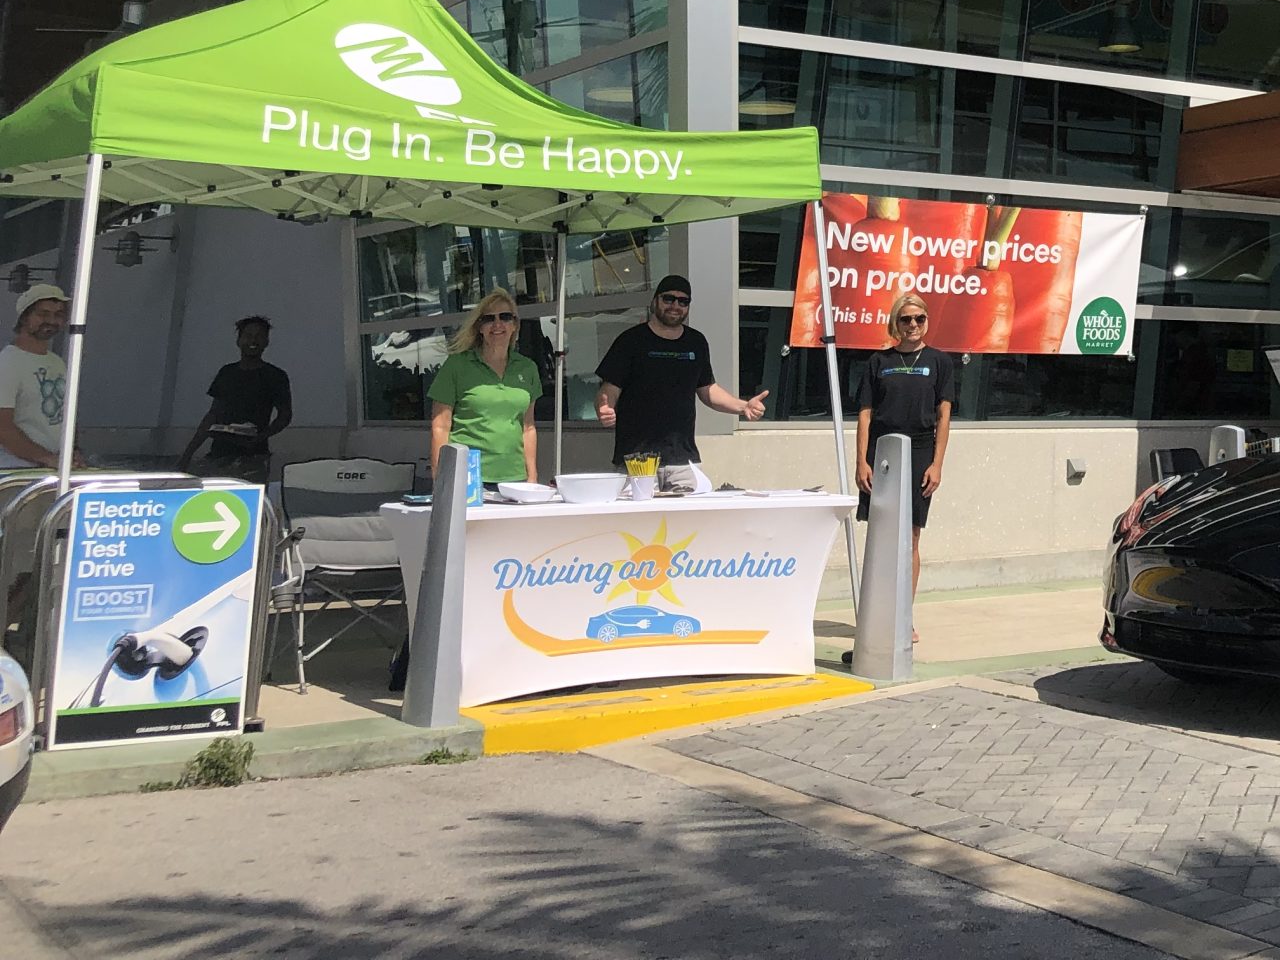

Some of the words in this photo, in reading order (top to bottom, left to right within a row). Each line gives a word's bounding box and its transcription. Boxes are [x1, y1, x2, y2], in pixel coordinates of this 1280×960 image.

[261, 104, 372, 161] Plug
[392, 120, 444, 164] In.
[465, 130, 525, 169] Be
[543, 136, 693, 181] Happy.
[827, 221, 895, 254] New
[902, 227, 978, 259] lower
[982, 234, 1062, 266] prices
[827, 266, 859, 289] on
[866, 264, 988, 296] produce.
[860, 308, 873, 324] is
[1082, 314, 1123, 328] WHOLE
[1082, 327, 1121, 341] FOODS
[336, 472, 366, 480] CORE
[84, 500, 166, 519] Electric
[84, 520, 161, 538] Vehicle
[82, 540, 126, 558] Test
[78, 559, 135, 578] Drive
[493, 557, 611, 594] Driving
[618, 559, 660, 580] on
[666, 550, 797, 579] Sunshine
[82, 590, 147, 606] BOOST
